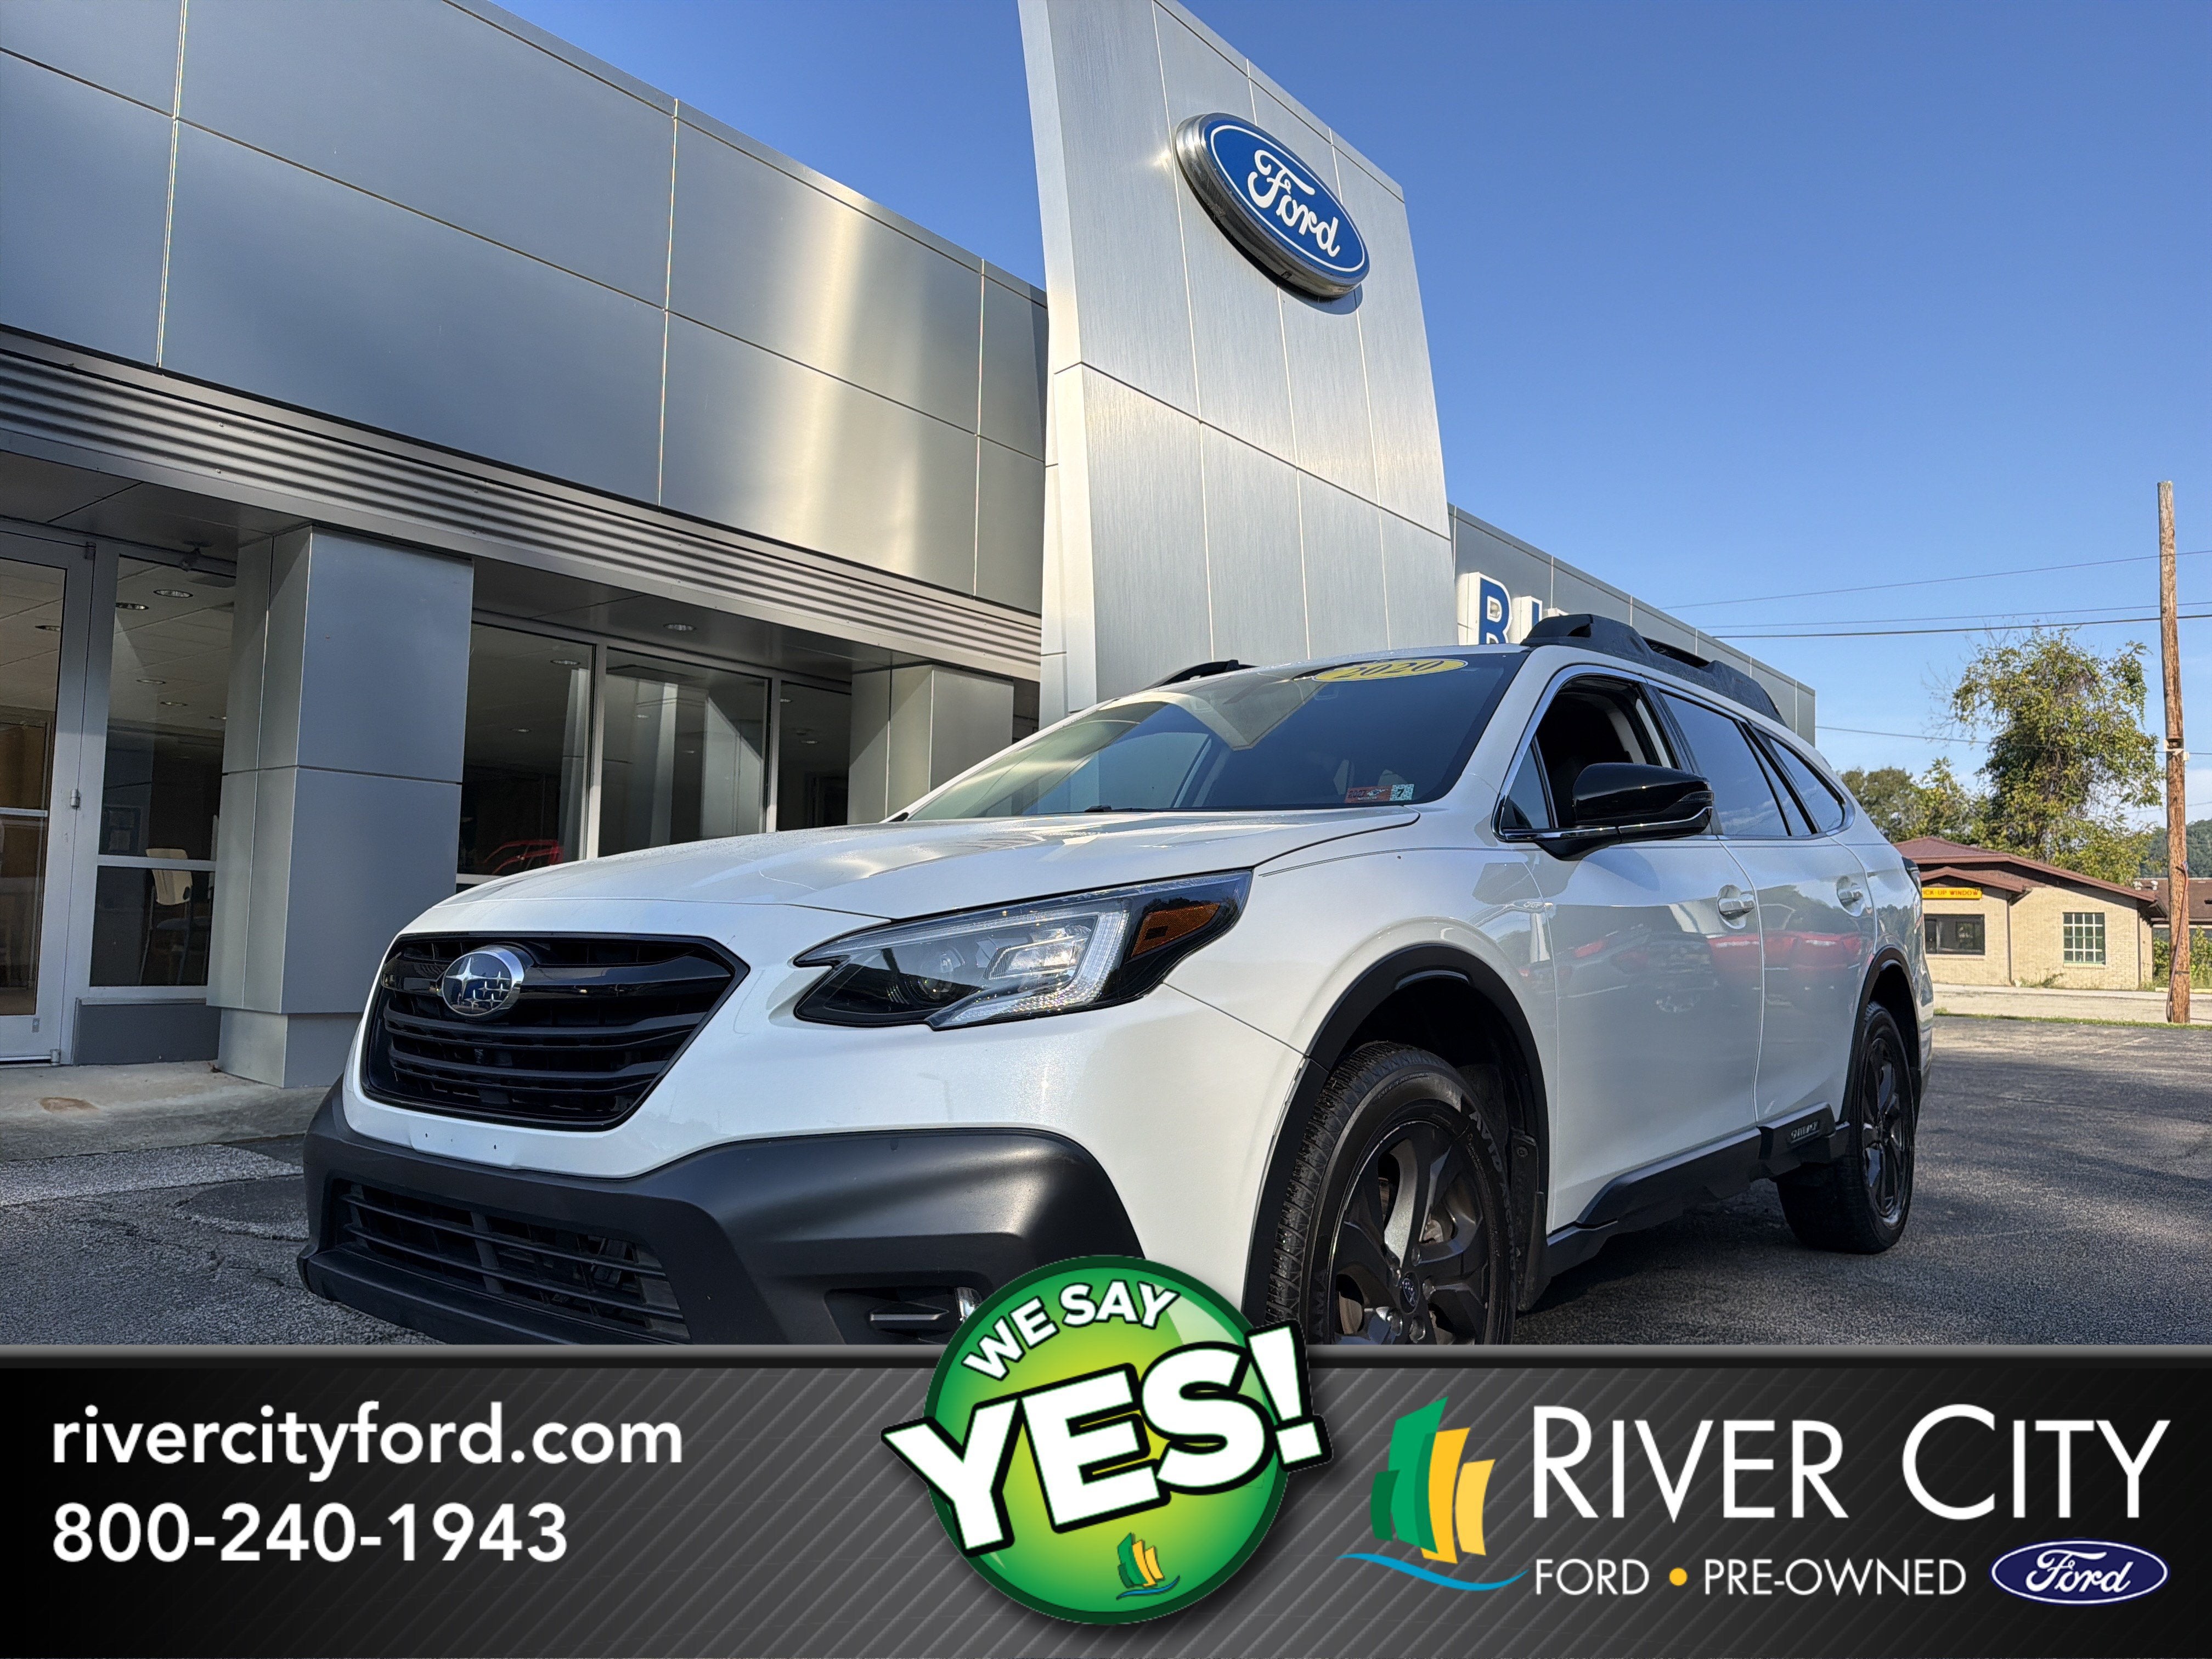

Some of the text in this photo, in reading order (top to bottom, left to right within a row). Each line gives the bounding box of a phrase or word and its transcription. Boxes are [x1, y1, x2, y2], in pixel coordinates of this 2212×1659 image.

[1247, 149, 1341, 257] Ford
[1331, 659, 1445, 679] 2020
[1397, 788, 1405, 798] 7
